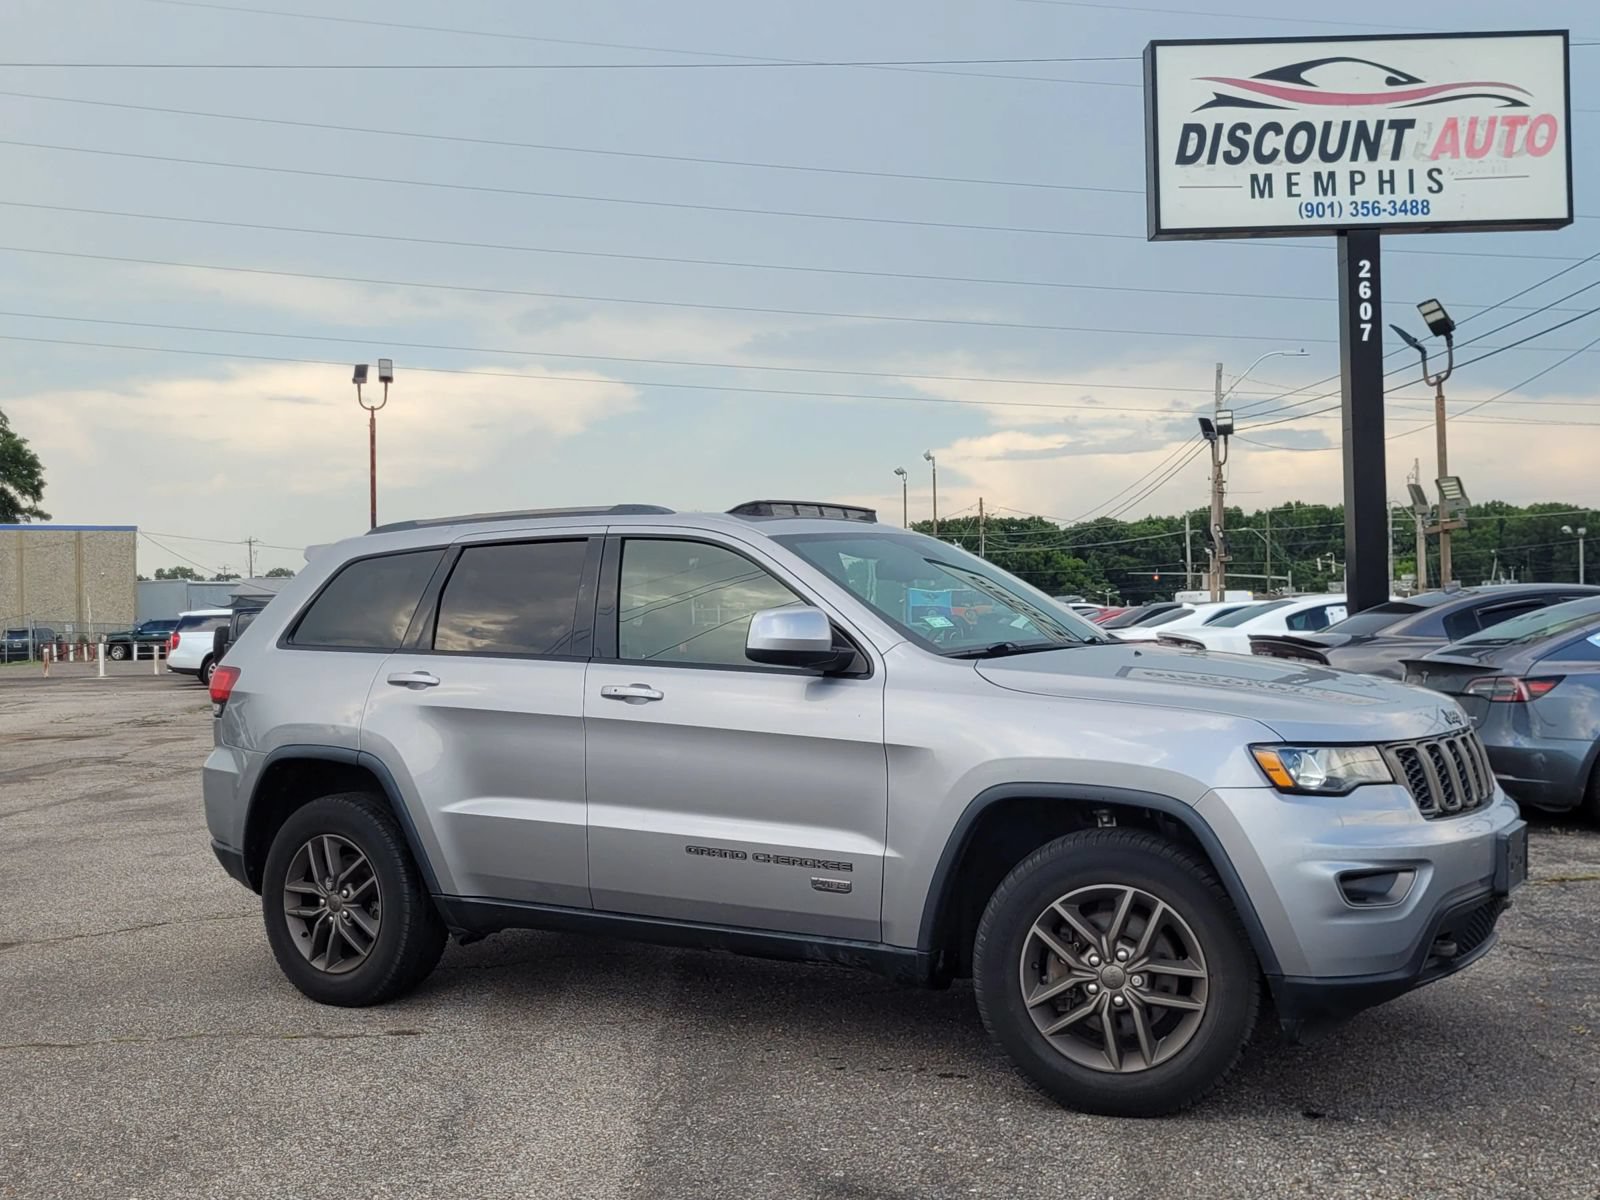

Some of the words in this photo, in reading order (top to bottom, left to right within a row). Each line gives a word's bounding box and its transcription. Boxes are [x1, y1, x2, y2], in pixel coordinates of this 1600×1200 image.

[1174, 118, 1416, 165] DISCOUNT
[1430, 113, 1558, 160] AUTO
[1249, 167, 1444, 199] MEMPHIS
[1298, 202, 1343, 219] (901)
[1349, 199, 1431, 218] 356-3488
[1358, 259, 1372, 342] 2607
[686, 845, 747, 861] GRAND
[752, 853, 853, 872] CHEROKEE
